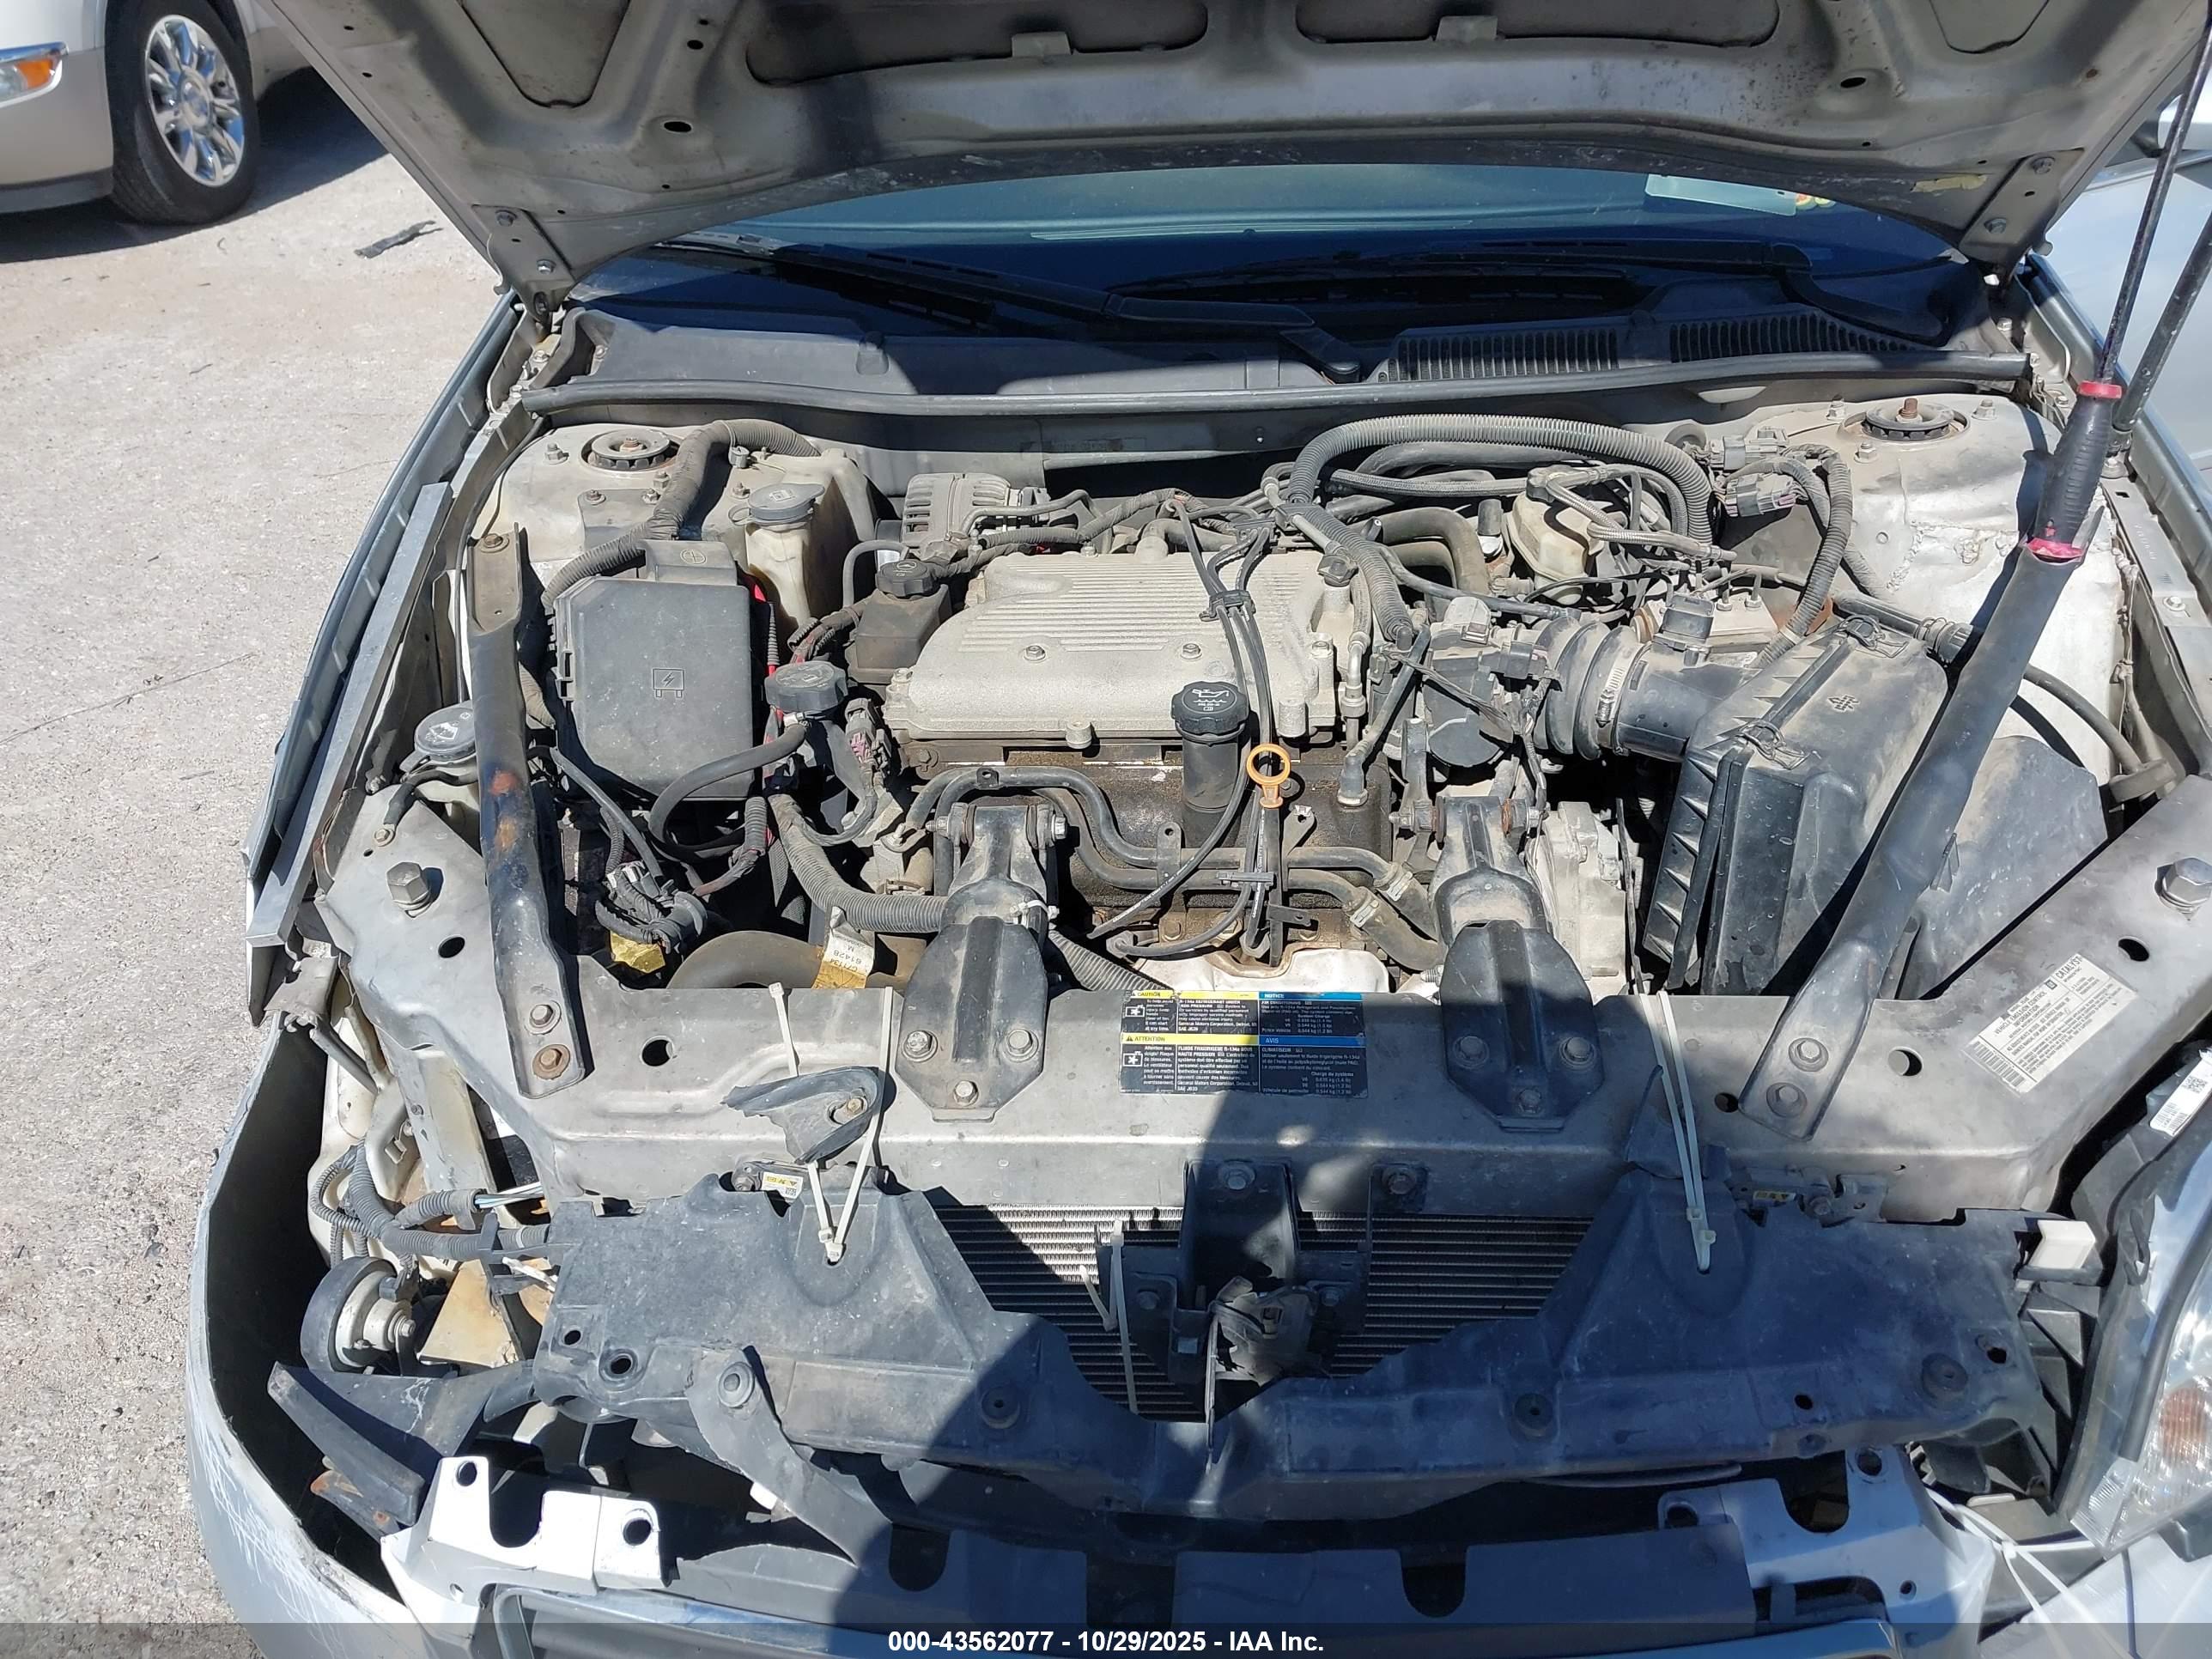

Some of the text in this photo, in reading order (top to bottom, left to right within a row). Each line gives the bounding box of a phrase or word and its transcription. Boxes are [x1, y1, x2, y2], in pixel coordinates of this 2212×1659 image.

[833, 950, 862, 964] 61428
[2055, 955, 2082, 979] CATALYST
[2027, 991, 2048, 1006] CONTROL
